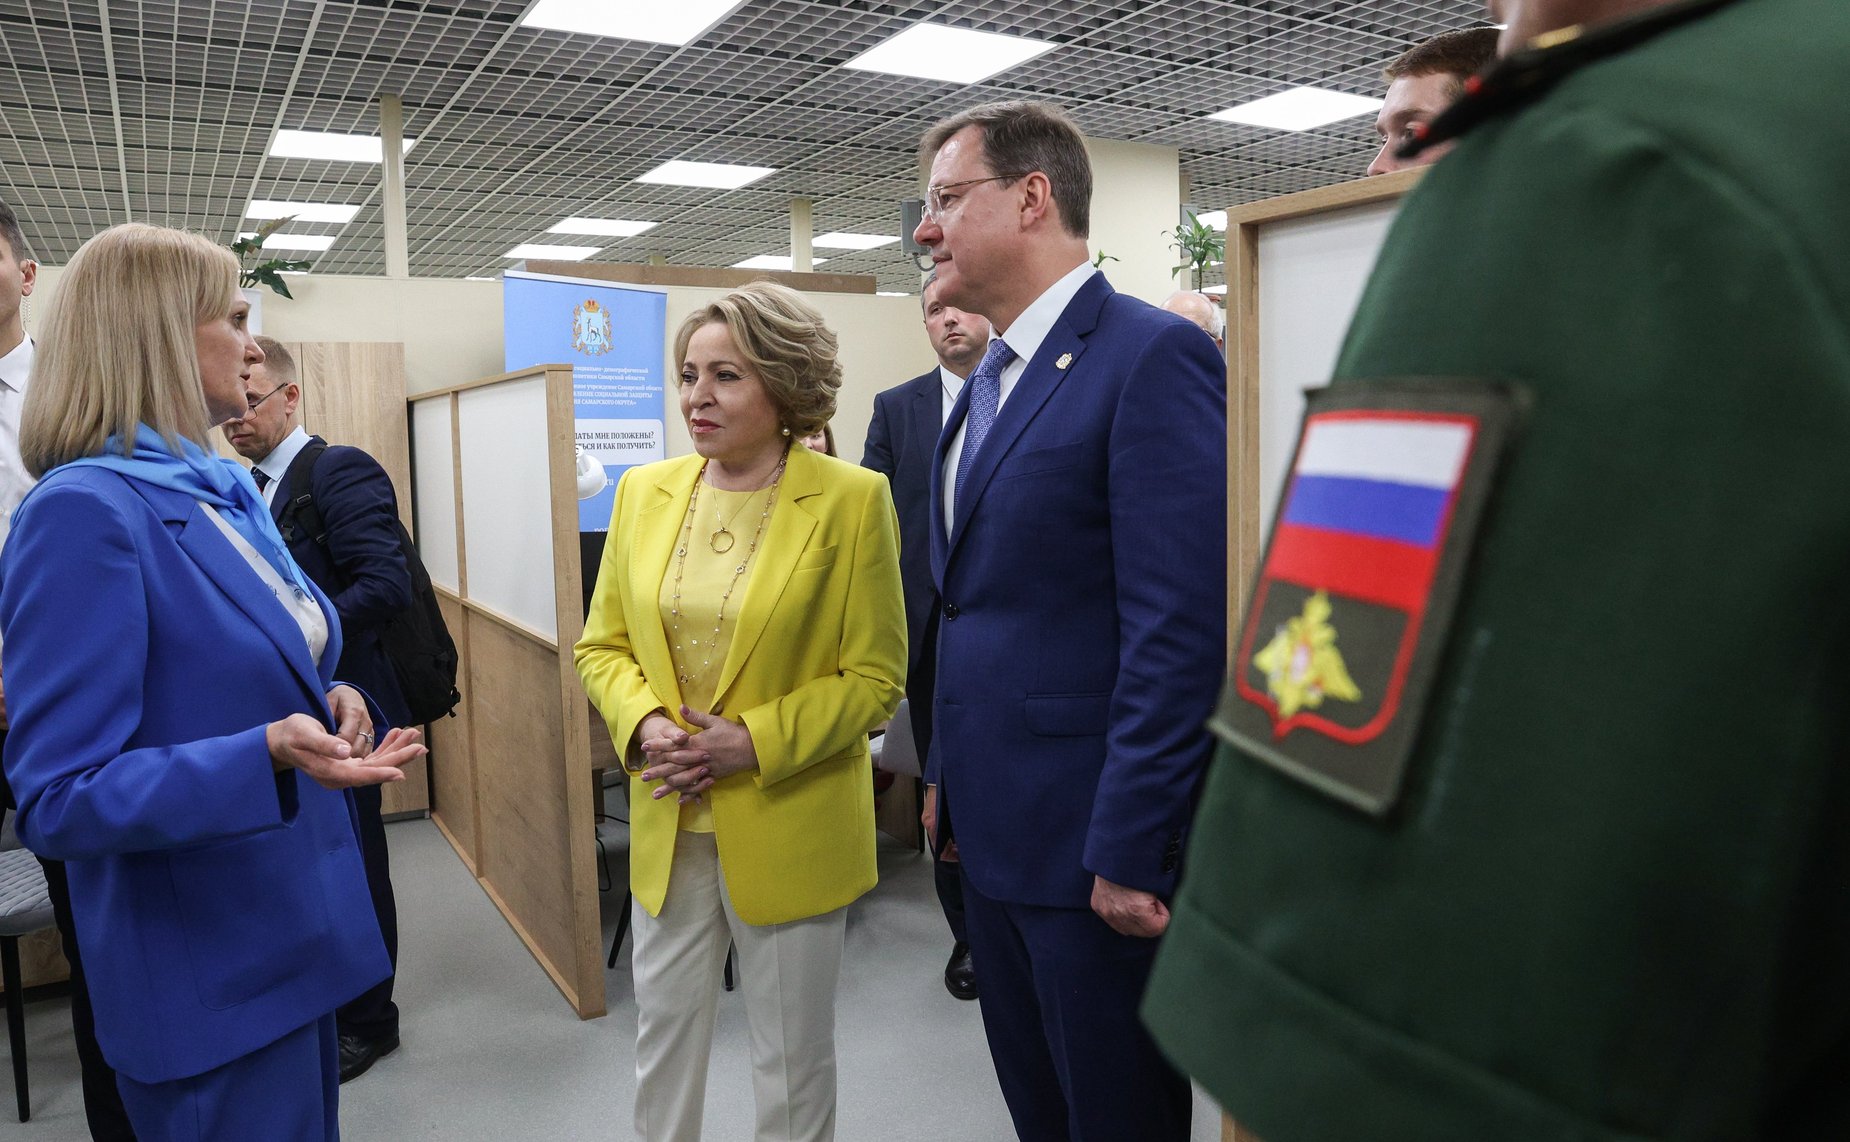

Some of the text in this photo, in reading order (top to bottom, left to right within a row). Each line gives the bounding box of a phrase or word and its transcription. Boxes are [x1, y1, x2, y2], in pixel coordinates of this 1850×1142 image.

[594, 432, 610, 440] МНЕ
[611, 431, 655, 439] ПОЛОЖЕНЫ?
[617, 441, 656, 450] ПОЛУЧИТЬ?
